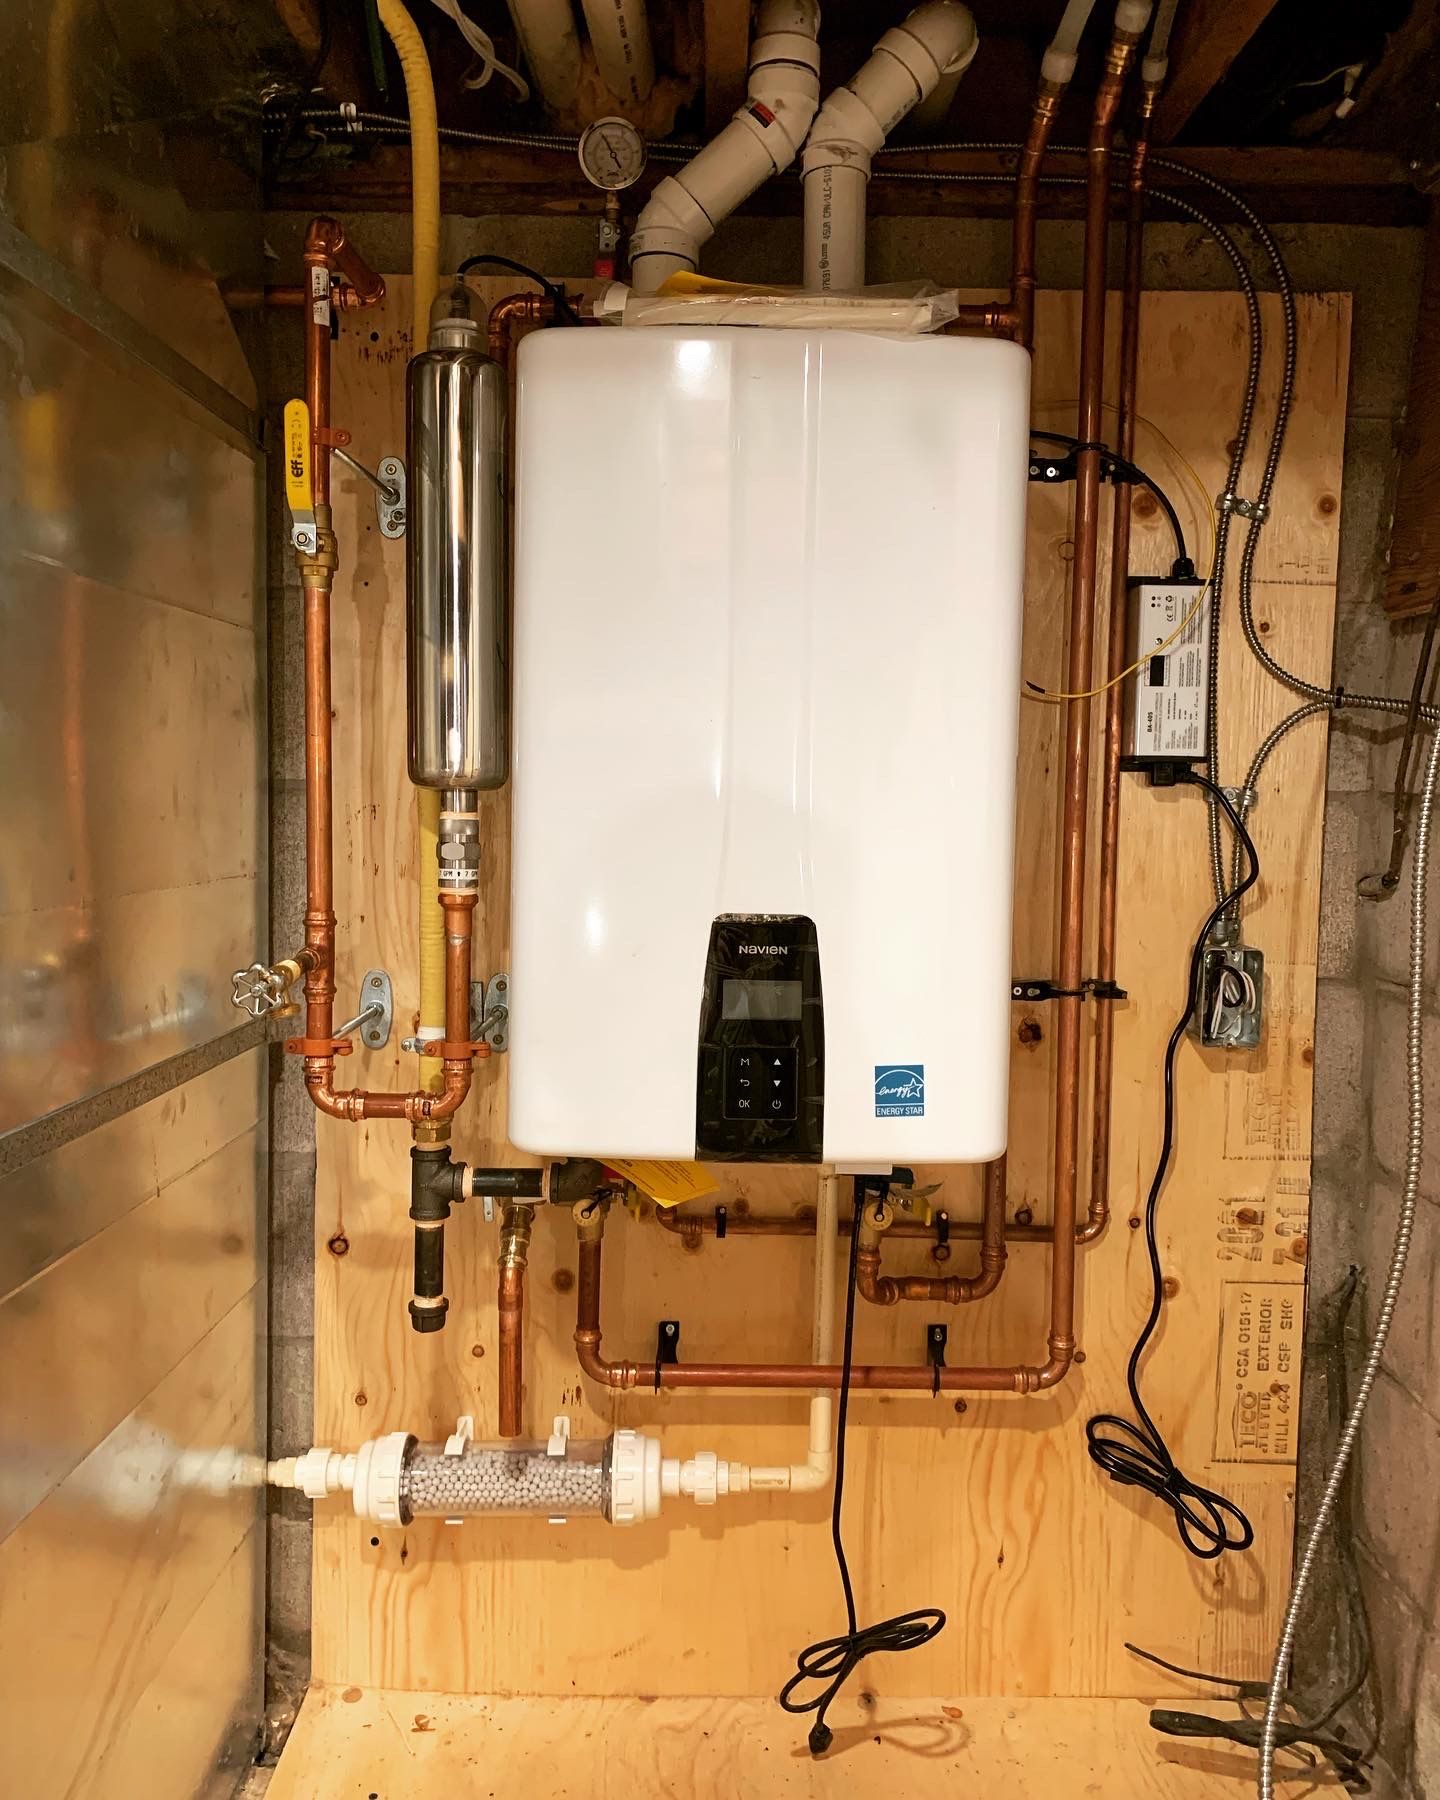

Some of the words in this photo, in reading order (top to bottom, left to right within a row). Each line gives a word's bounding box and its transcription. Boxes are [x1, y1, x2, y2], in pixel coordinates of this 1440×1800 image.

[738, 1099, 750, 1108] OK
[876, 1107, 904, 1116] ENERGY
[905, 1106, 923, 1115] STAR
[1257, 1298, 1272, 1371] EXTERIOR
[1236, 1348, 1250, 1378] CSA
[1239, 1391, 1257, 1448] TECO
[1274, 1418, 1289, 1454] MILL
